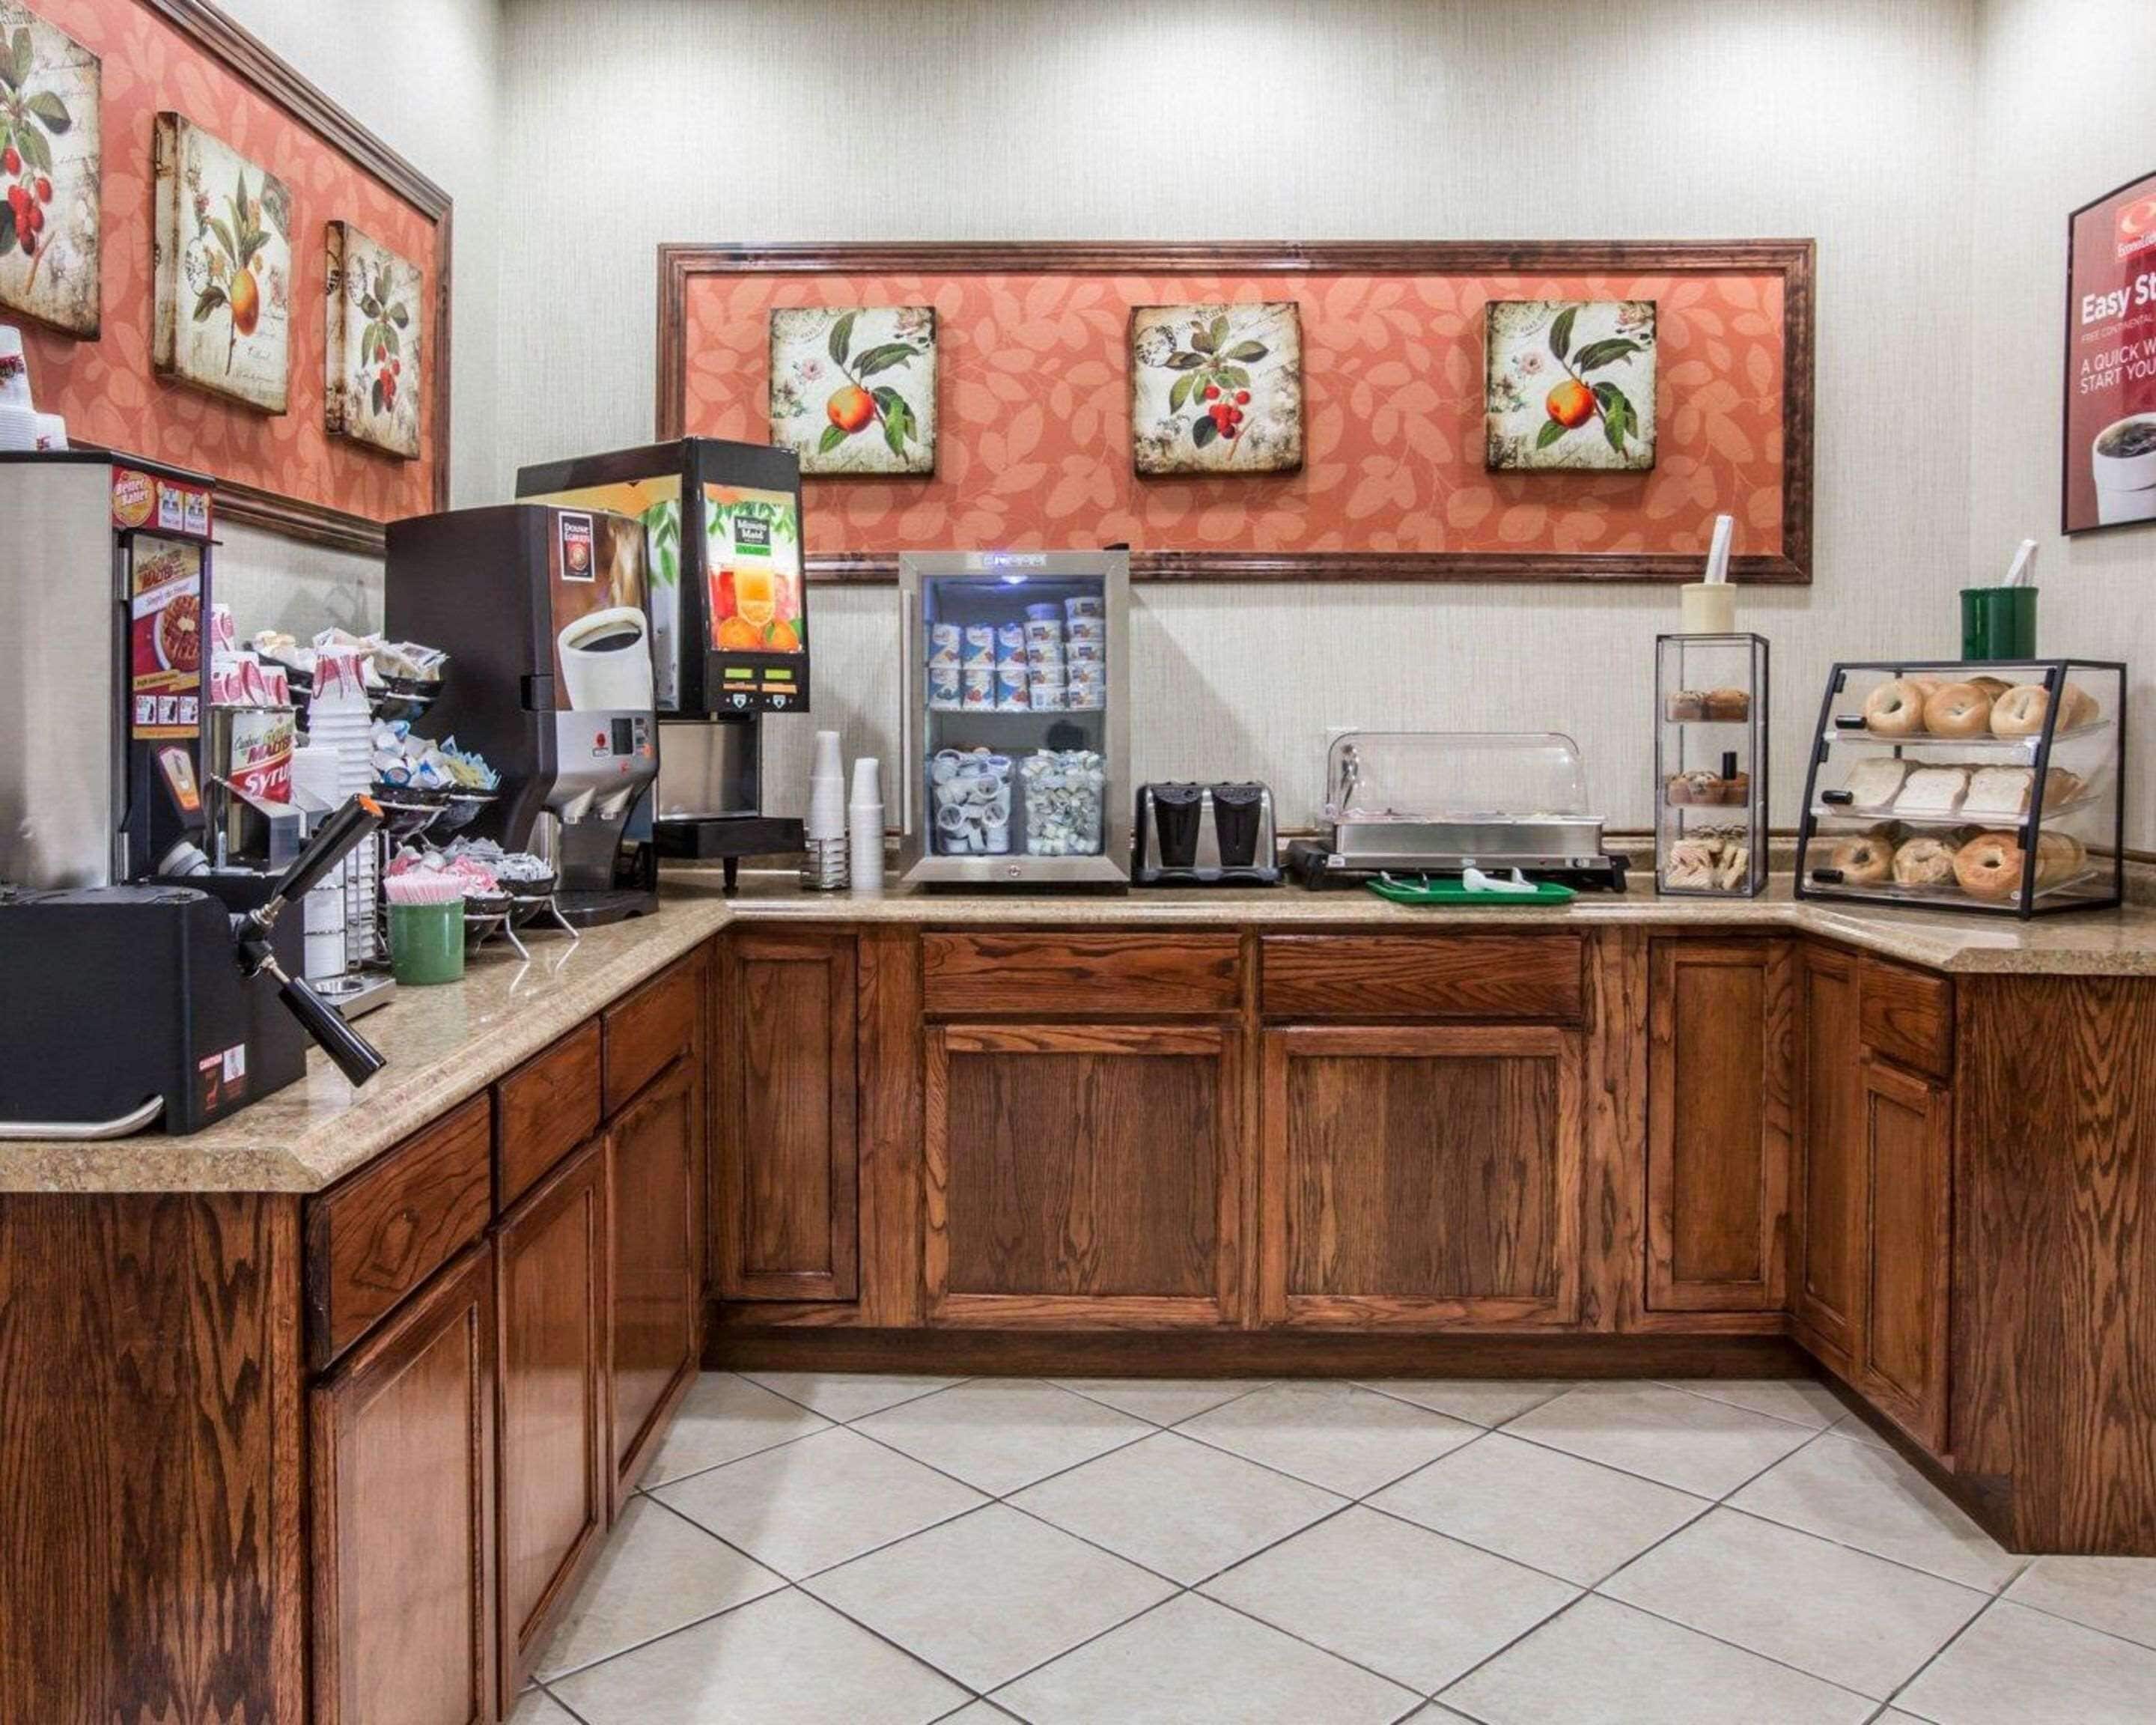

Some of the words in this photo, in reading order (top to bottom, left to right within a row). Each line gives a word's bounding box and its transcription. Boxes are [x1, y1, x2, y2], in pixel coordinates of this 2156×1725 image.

[2082, 287, 2131, 325] Easy
[2081, 359, 2091, 376] A
[2094, 342, 2140, 371] QUICK
[2080, 366, 2123, 395] START
